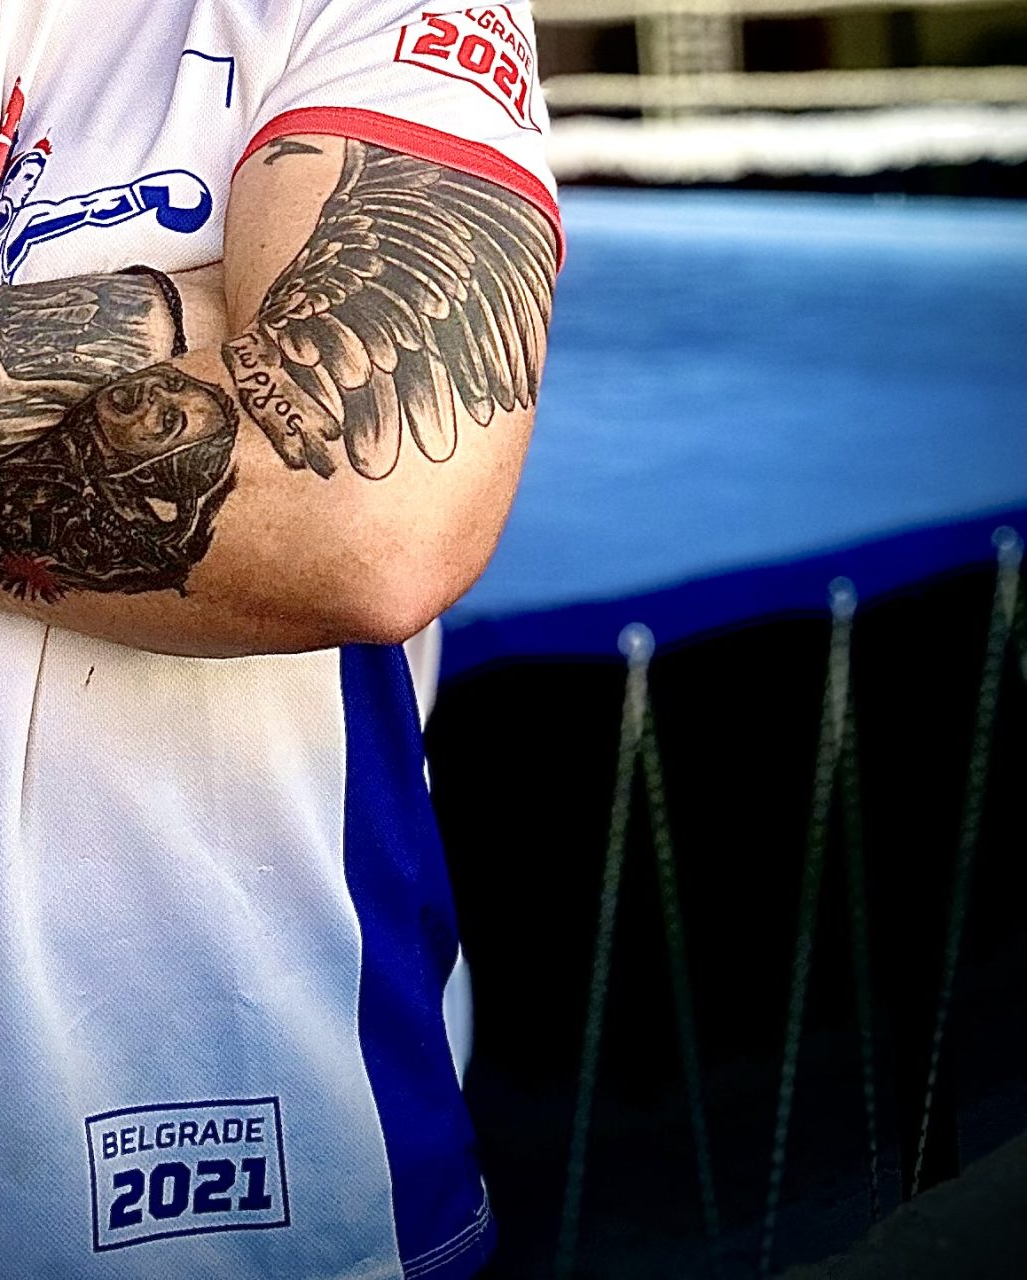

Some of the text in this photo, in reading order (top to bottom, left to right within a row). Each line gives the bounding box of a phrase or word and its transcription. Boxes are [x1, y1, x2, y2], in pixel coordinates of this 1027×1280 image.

[412, 17, 527, 120] 2021
[102, 1117, 265, 1160] BELGRADE
[108, 1156, 272, 1231] 2021
